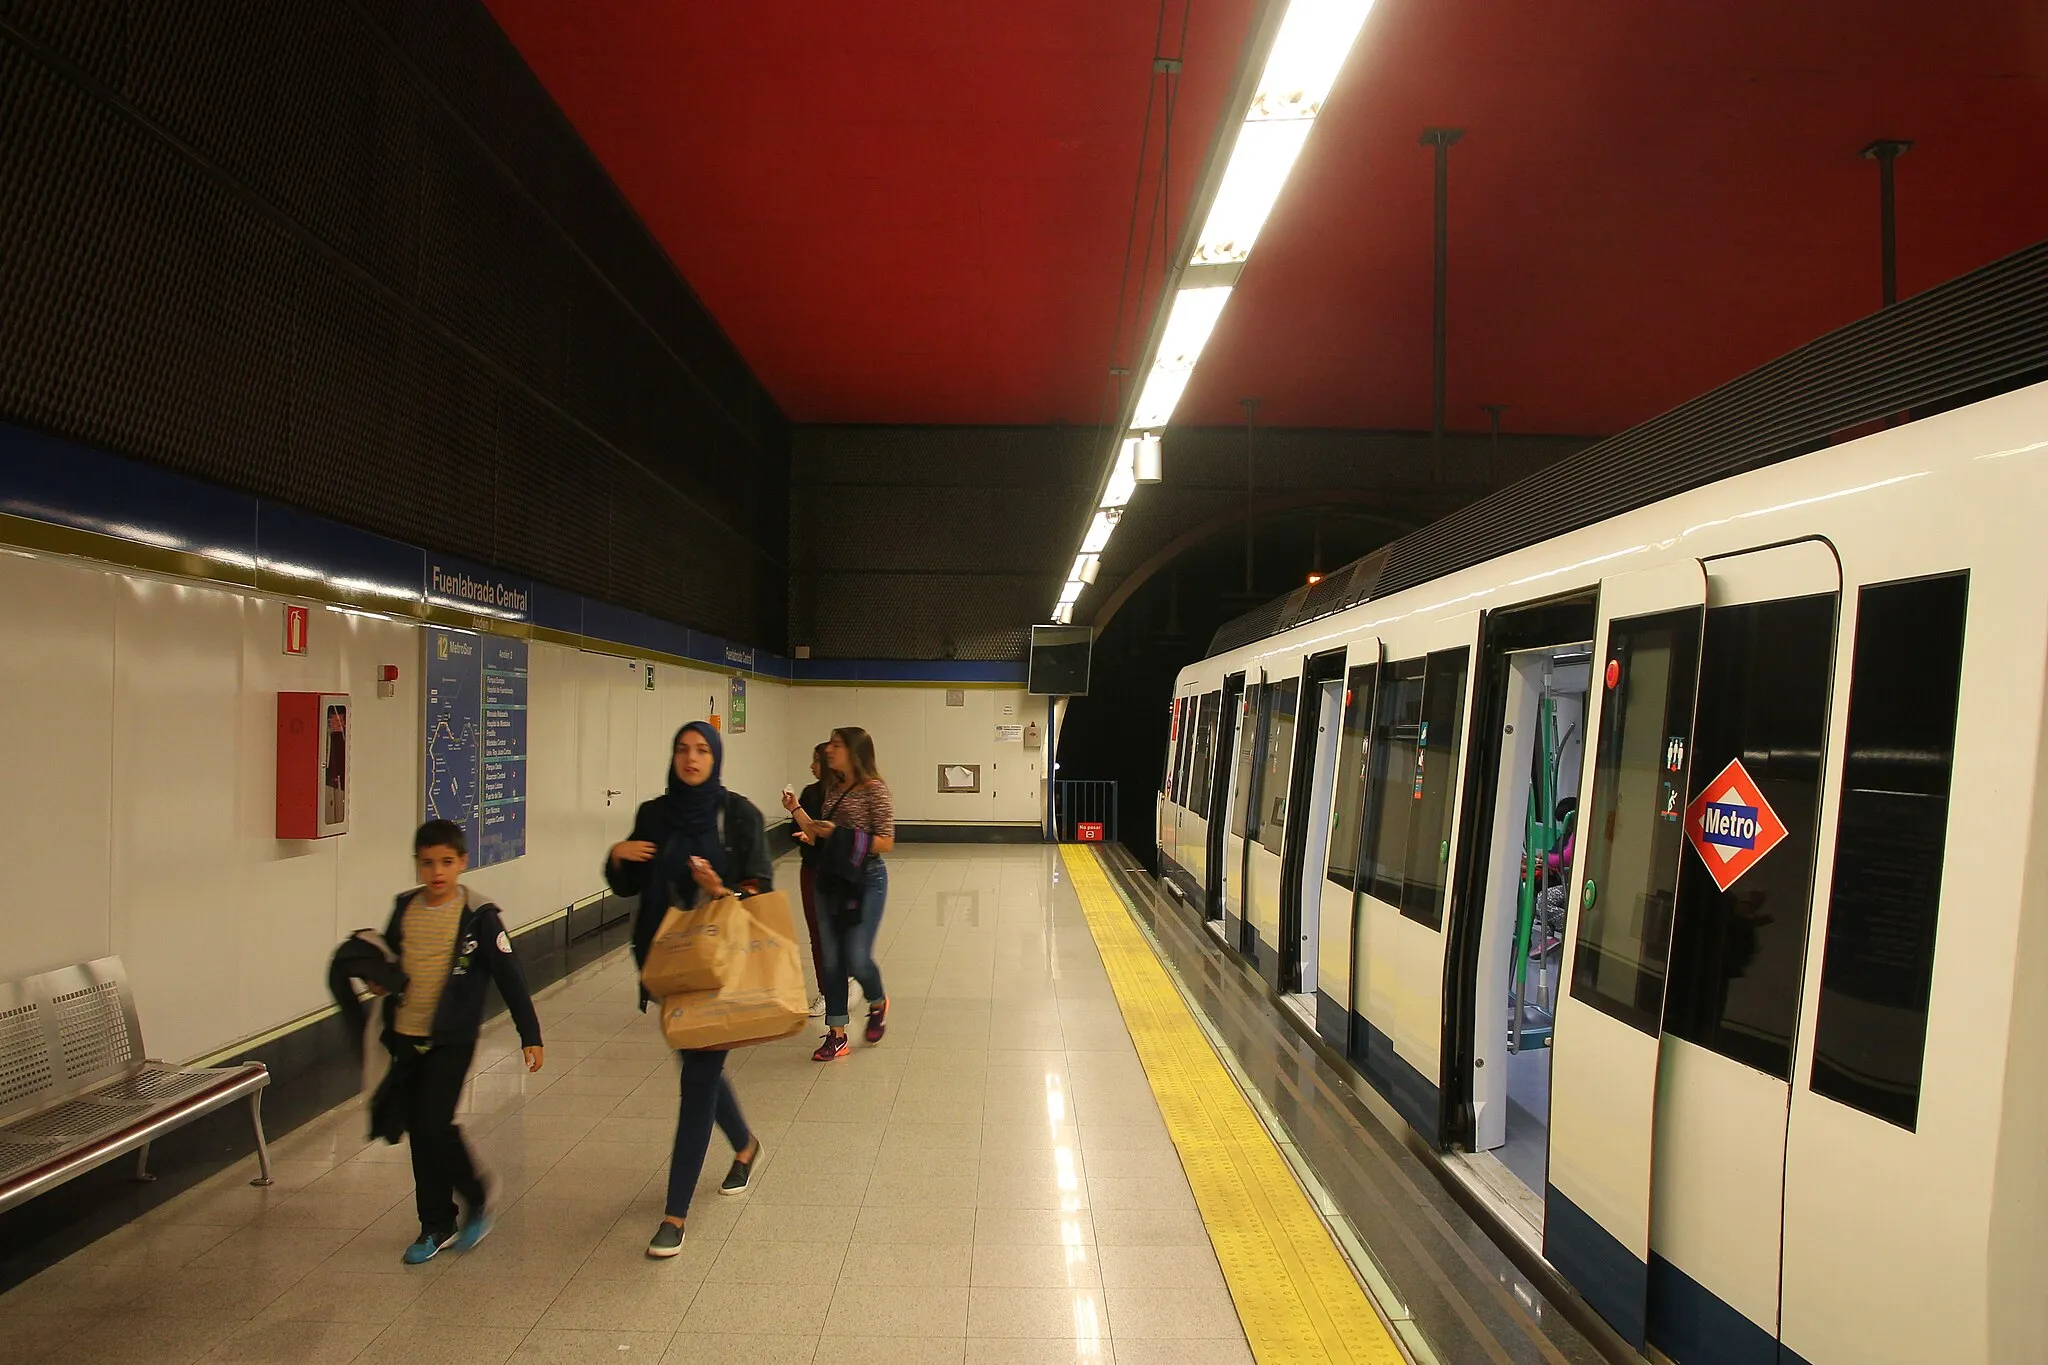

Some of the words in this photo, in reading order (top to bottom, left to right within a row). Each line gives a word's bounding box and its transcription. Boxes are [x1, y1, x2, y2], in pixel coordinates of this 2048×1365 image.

[433, 566, 494, 604] Fuenlabrada
[496, 583, 528, 612] Central
[438, 636, 448, 659] 12
[449, 641, 473, 656] MetroSur
[1705, 808, 1754, 839] Metro
